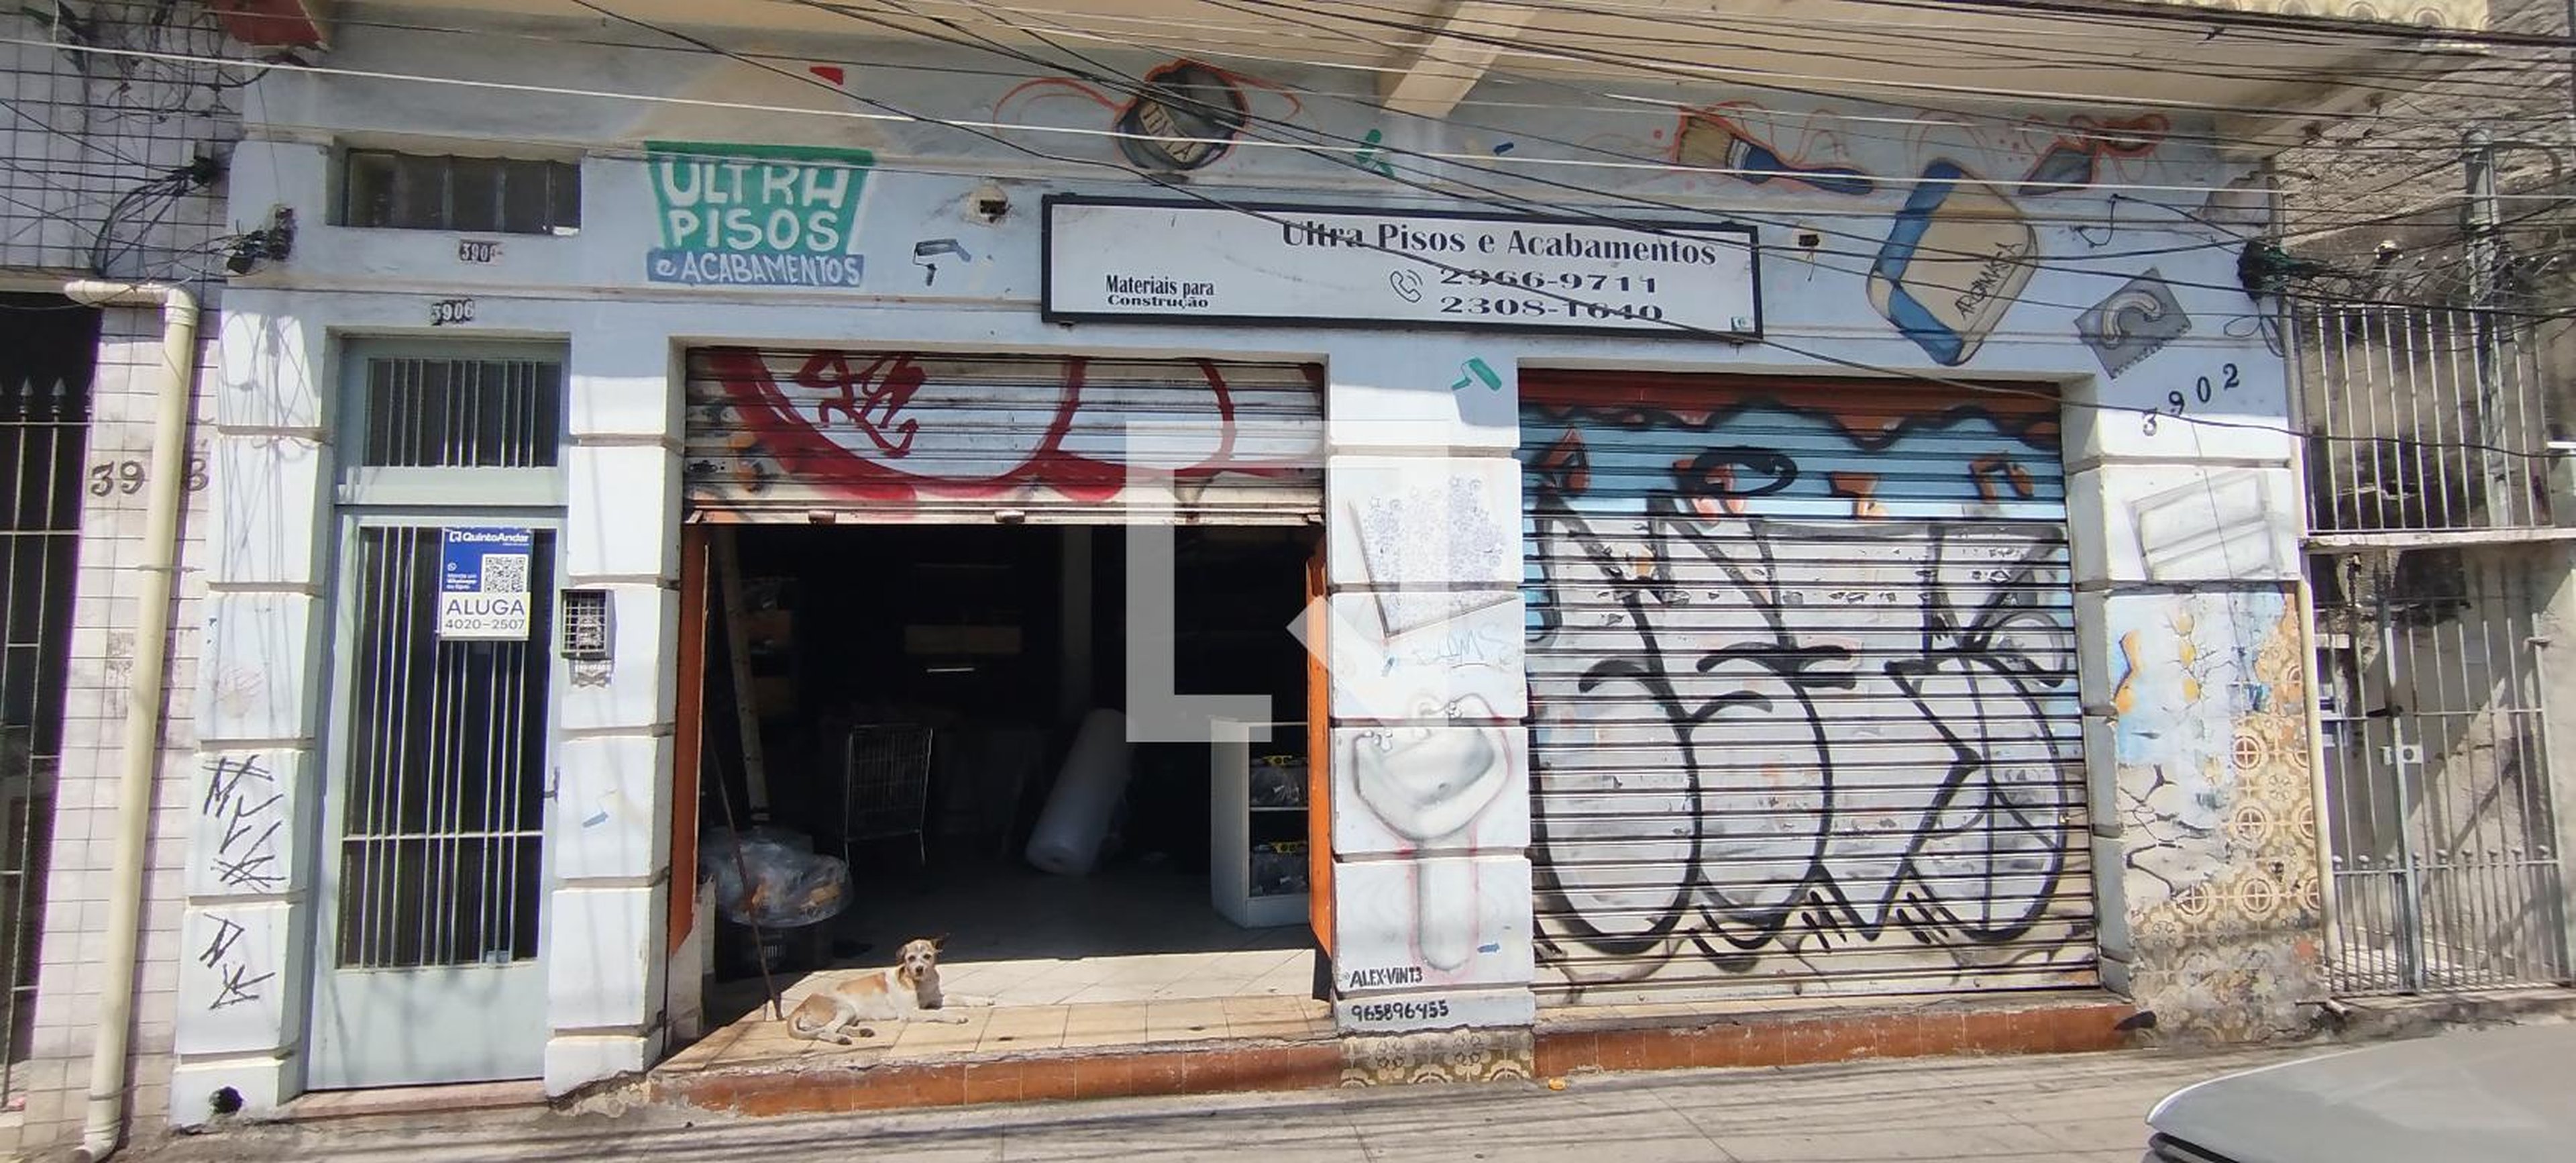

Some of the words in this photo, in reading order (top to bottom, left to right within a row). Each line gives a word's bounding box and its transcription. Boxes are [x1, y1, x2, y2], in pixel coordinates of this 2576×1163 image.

[662, 156, 849, 208] ULTRA
[668, 208, 839, 252] PISOS
[1283, 221, 1364, 248] Ultra
[1378, 223, 1465, 252] Pisos
[1478, 234, 1495, 254] e
[1507, 230, 1717, 265] Acabamentos
[680, 251, 859, 286] ACABAMENTOS
[1440, 268, 1656, 293] 2966-9711
[1106, 274, 1177, 295] Materiais
[1182, 281, 1214, 299] para
[1108, 295, 1208, 309] Construção
[1440, 297, 1662, 320] 2308-1640
[462, 532, 529, 542] QuintoAndar
[446, 599, 525, 615] ALUGA
[445, 619, 525, 629] 4020-2507
[1351, 1000, 1449, 1022] 965896455
